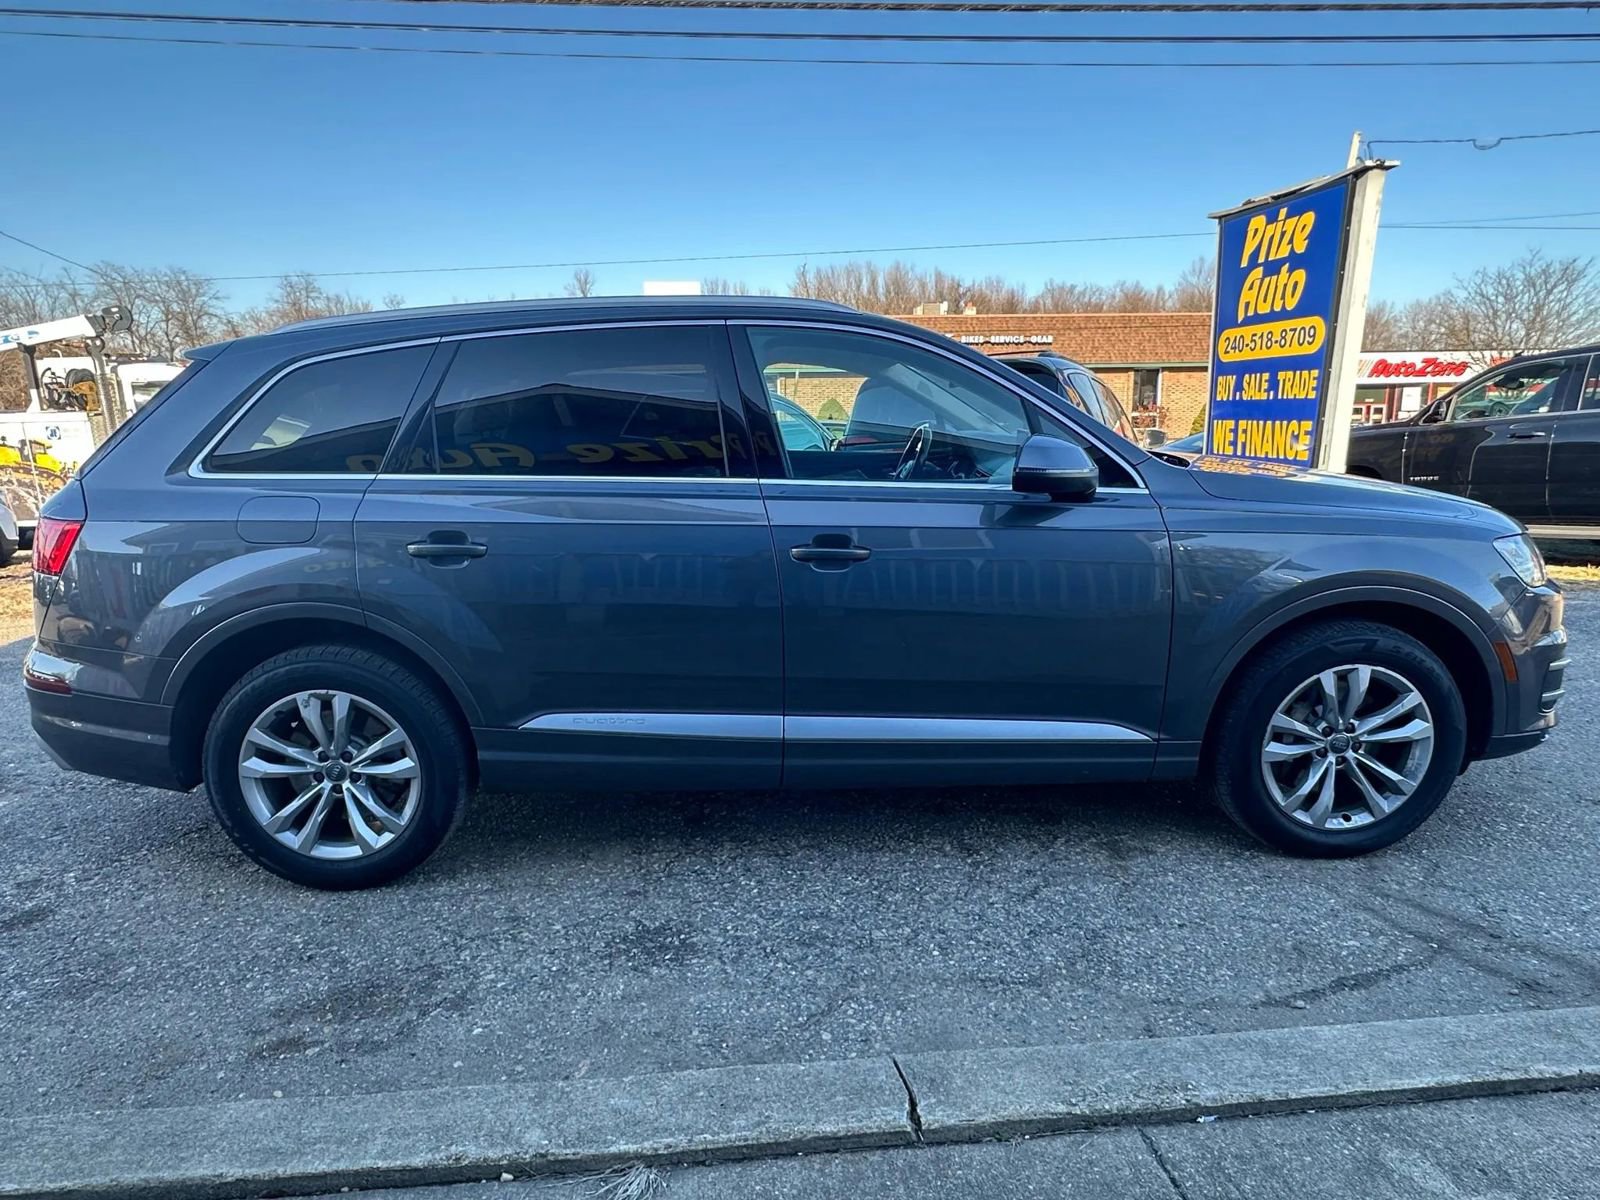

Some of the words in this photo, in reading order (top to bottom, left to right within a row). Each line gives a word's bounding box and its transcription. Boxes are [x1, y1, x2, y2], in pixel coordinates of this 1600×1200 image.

[1240, 207, 1316, 268] Prize
[1238, 262, 1307, 324] Auto
[960, 335, 984, 344] BIKES
[990, 335, 1025, 344] SERVICE
[1029, 335, 1054, 344] GEAR
[1223, 325, 1317, 355] 240-518-8709
[1368, 357, 1468, 378] AutoZone
[1277, 369, 1319, 399] TRADE
[1213, 419, 1235, 455] WE
[1236, 419, 1313, 461] FINANCE
